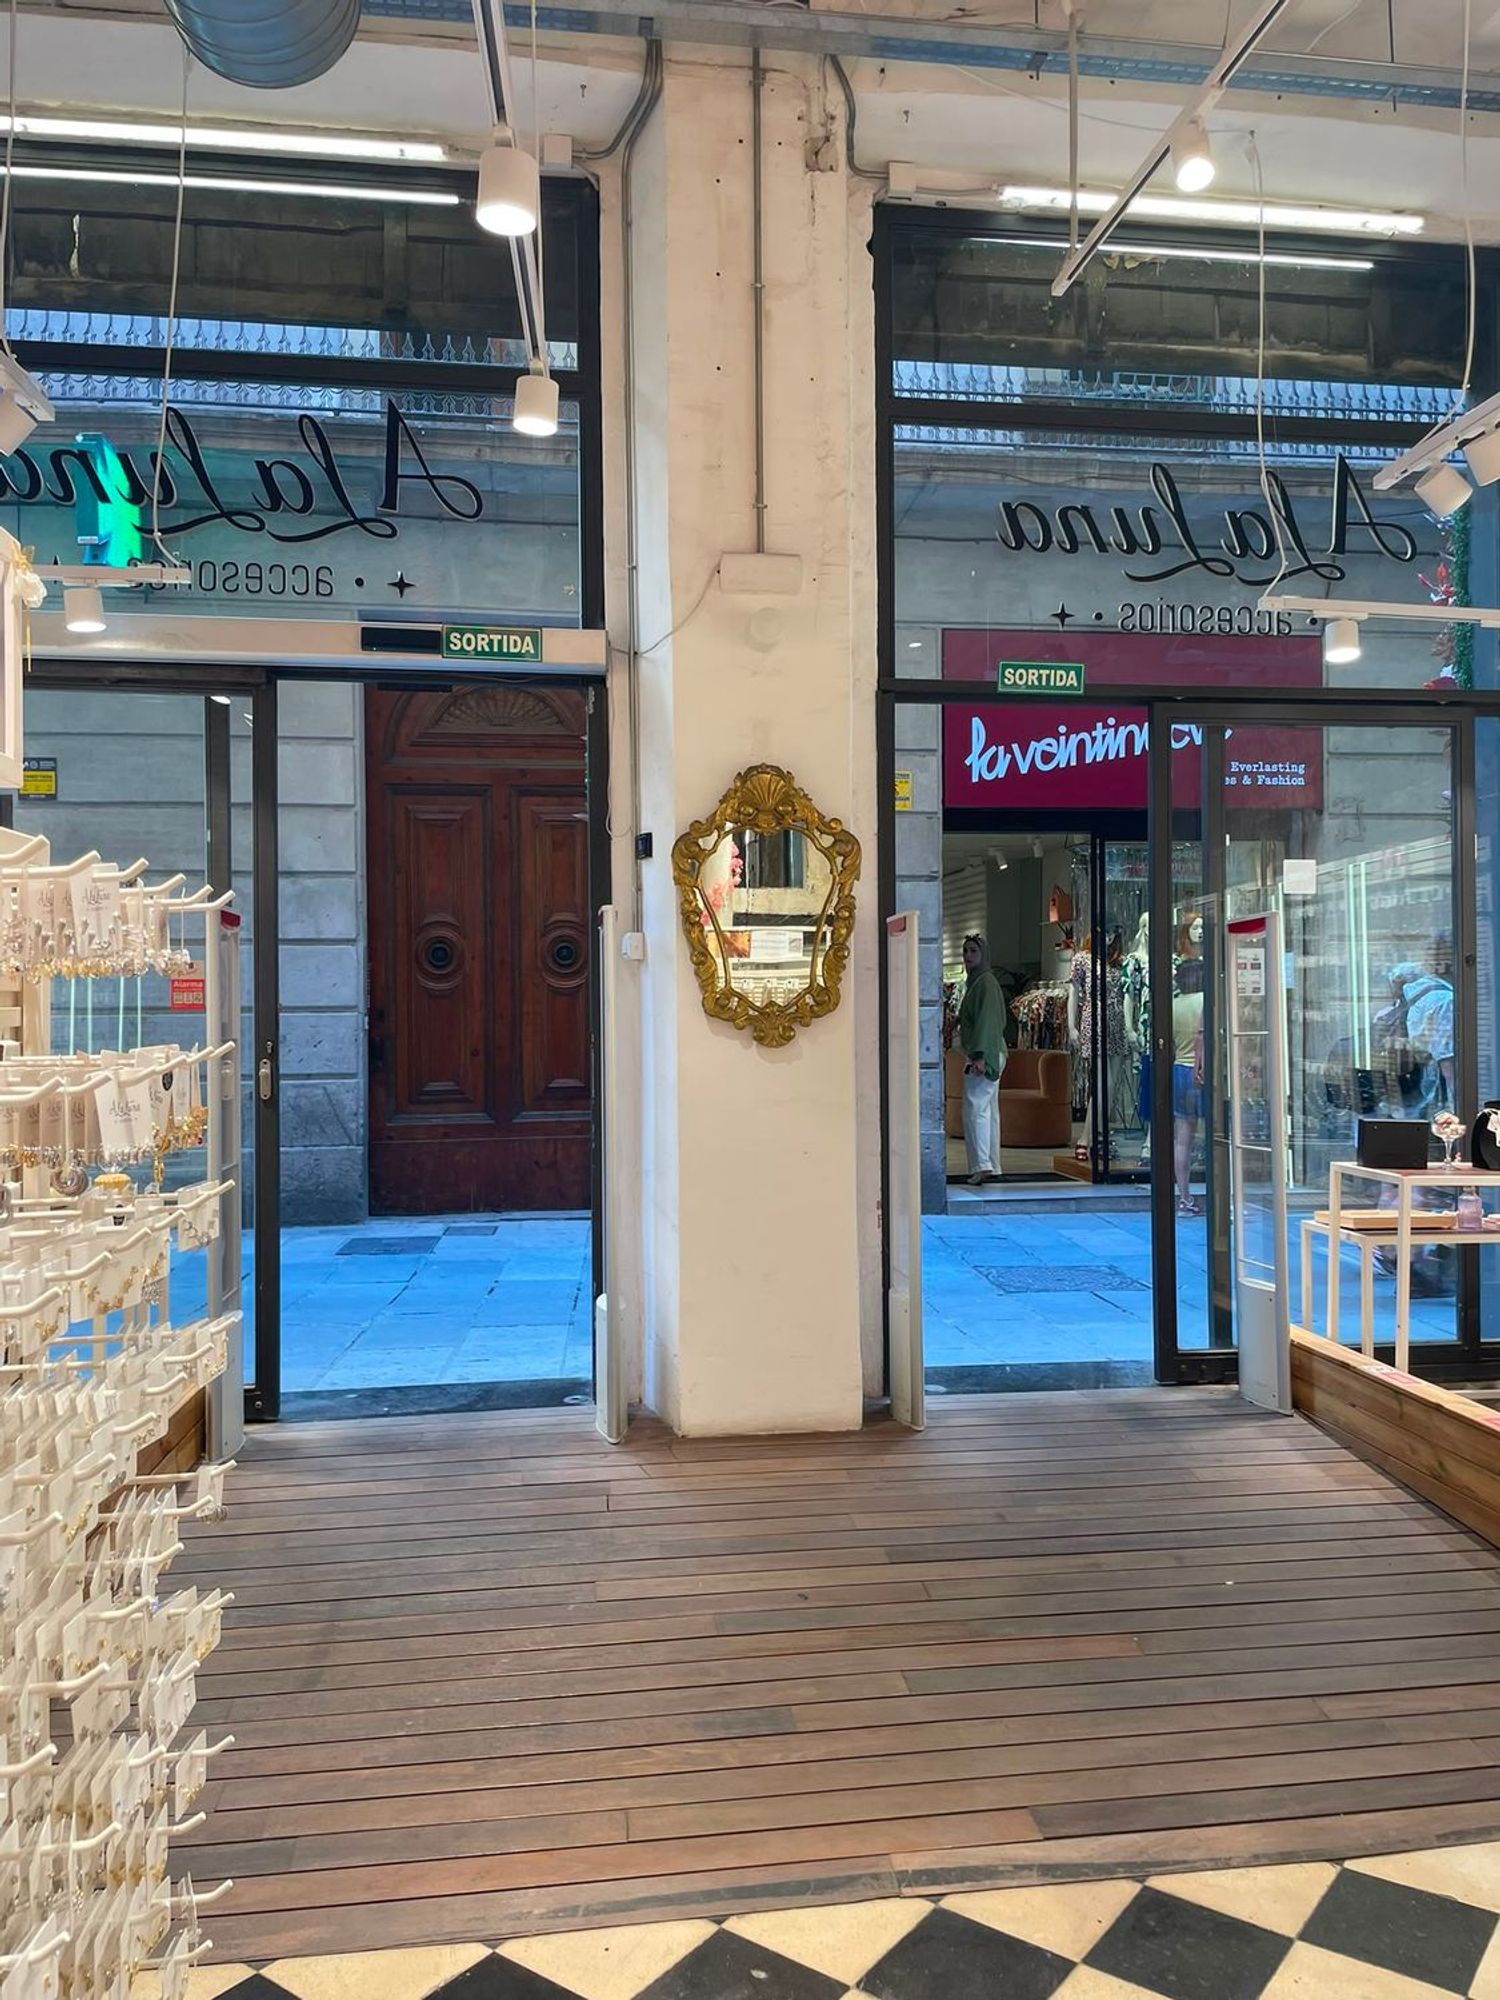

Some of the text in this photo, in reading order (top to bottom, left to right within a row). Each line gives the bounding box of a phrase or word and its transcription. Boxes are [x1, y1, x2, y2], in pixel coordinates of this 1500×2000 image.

[449, 631, 535, 654] SORTIDA
[1004, 668, 1078, 687] SORTIDA
[1230, 761, 1306, 774] Everlasting
[1242, 775, 1252, 785] &
[1257, 775, 1306, 785] Fashion
